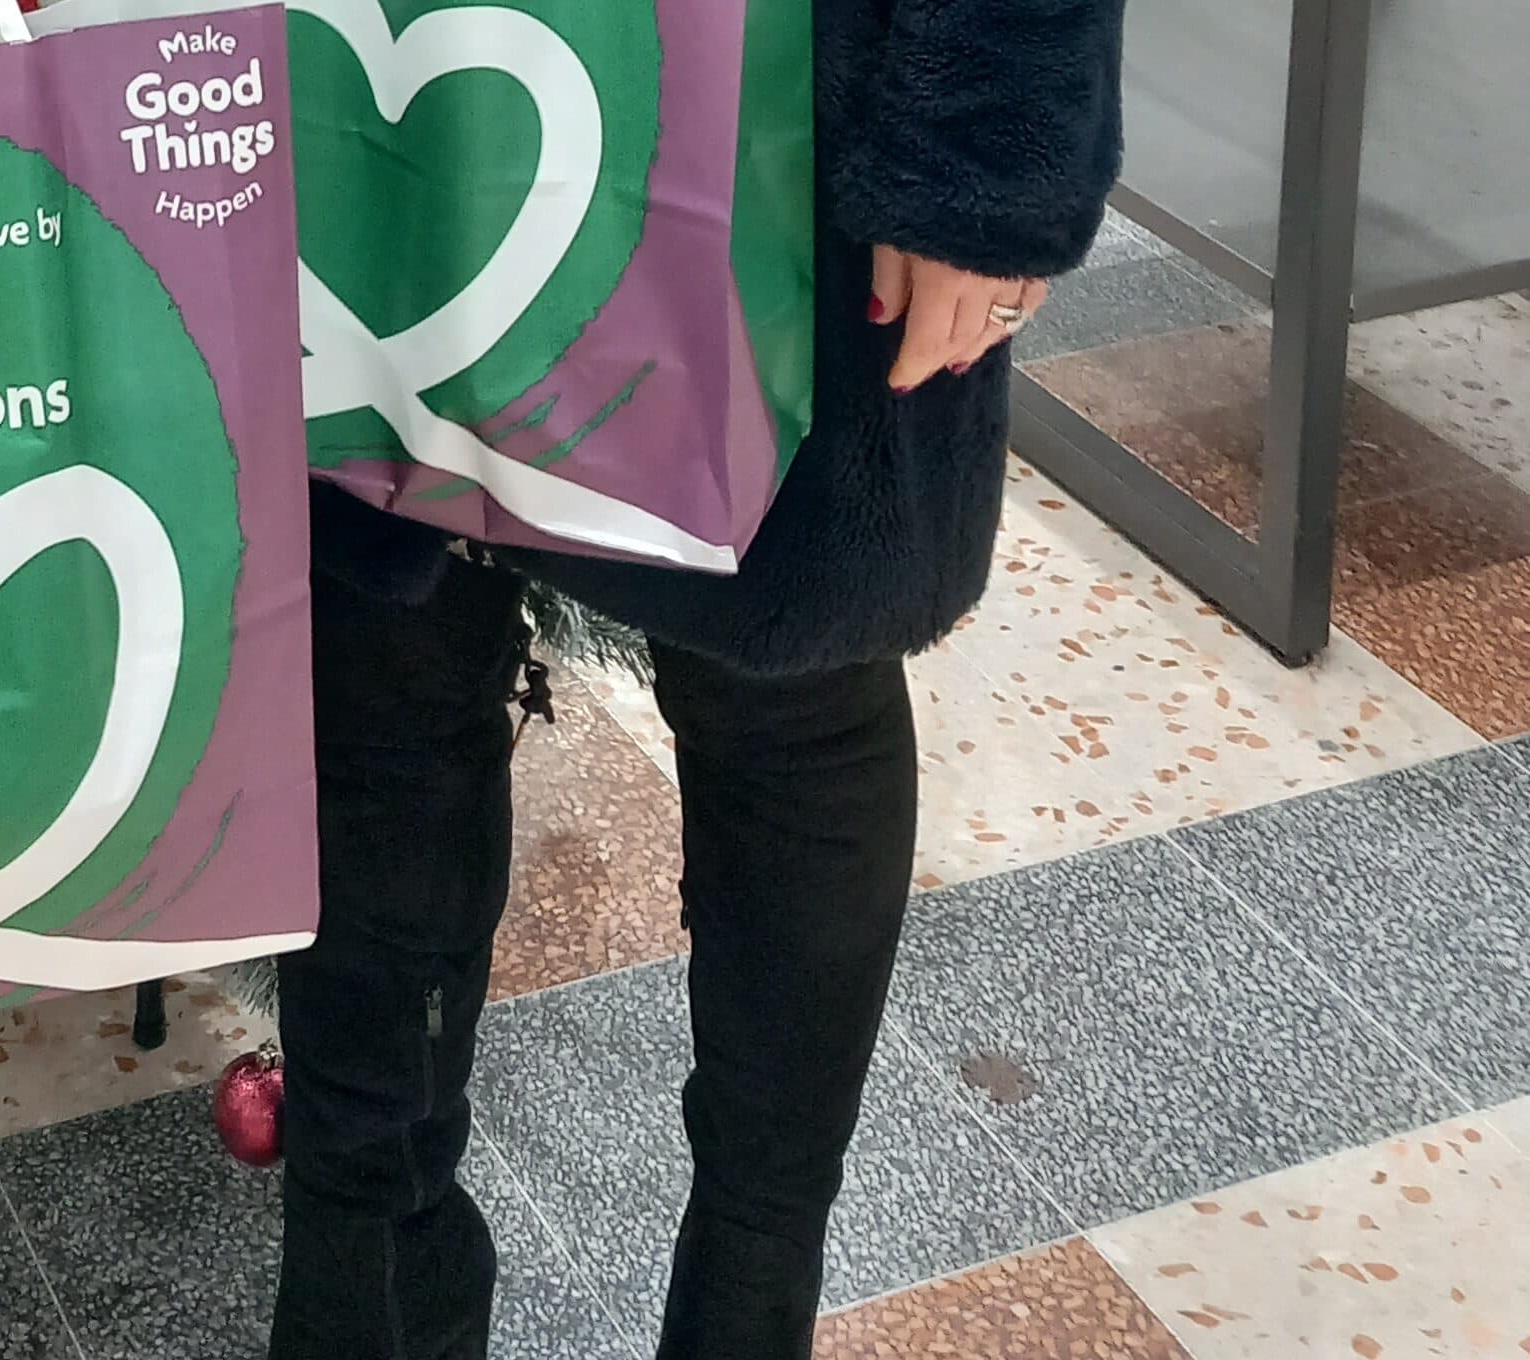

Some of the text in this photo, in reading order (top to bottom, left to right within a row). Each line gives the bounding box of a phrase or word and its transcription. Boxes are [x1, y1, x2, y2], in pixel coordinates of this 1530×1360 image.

[158, 24, 237, 64] Make
[125, 57, 263, 121] Good
[120, 119, 275, 175] Things
[36, 207, 62, 247] by
[154, 181, 264, 229] Happen
